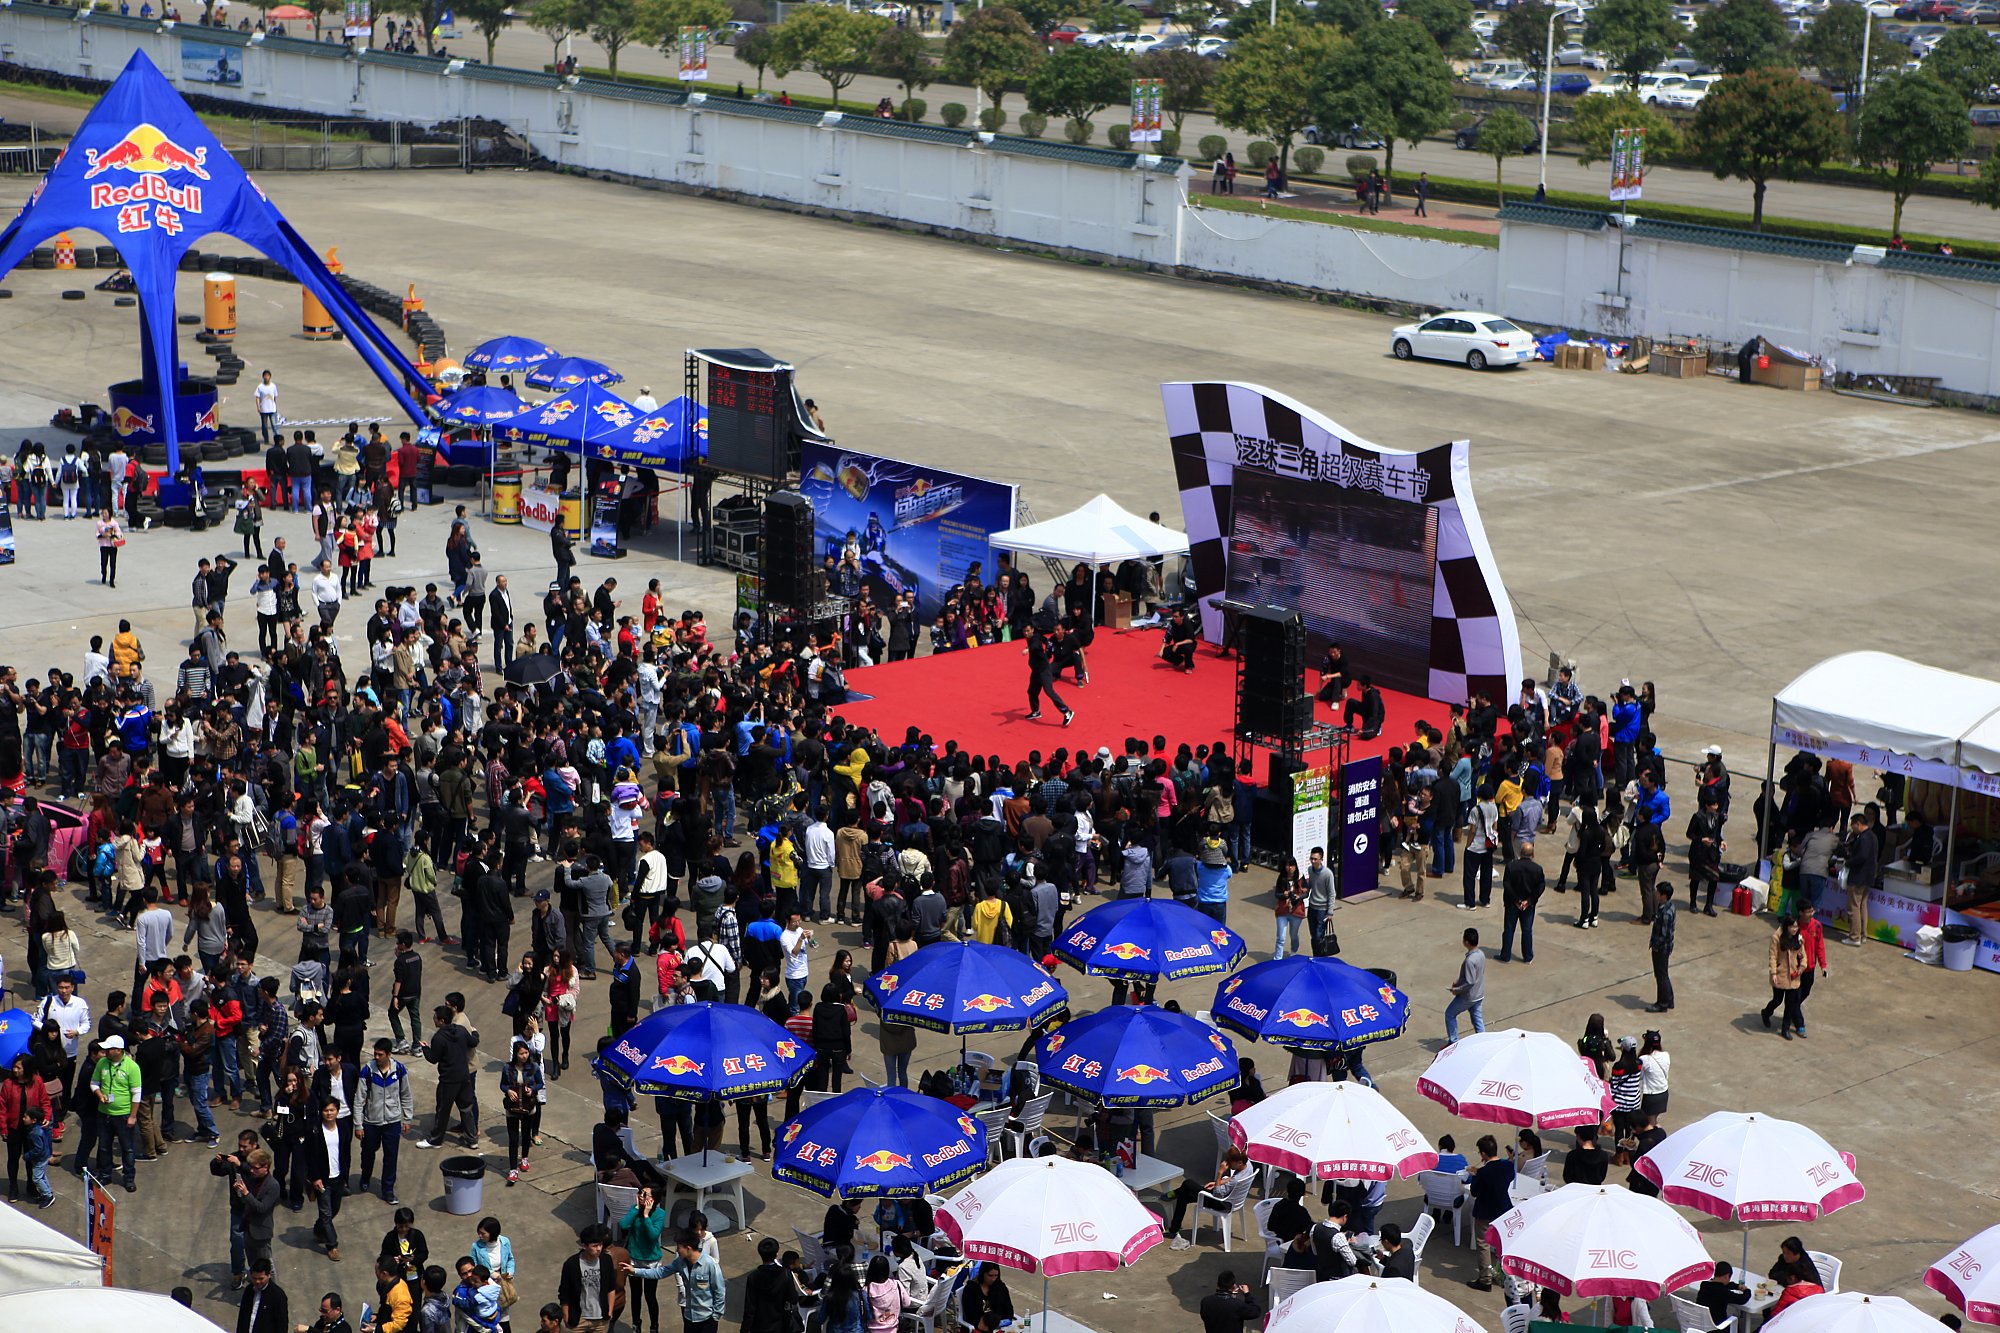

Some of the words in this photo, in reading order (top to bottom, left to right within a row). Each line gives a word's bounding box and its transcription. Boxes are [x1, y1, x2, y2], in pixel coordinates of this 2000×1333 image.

[117, 202, 183, 236] 红牛
[1235, 434, 1430, 498] 泛珠三角超级赛车节
[1859, 750, 1914, 772] 东八公
[1348, 778, 1377, 796] 消防安全
[1347, 807, 1376, 825] 请勿占用
[1068, 930, 1097, 951] 红牛
[1165, 944, 1212, 961] RedBull
[902, 989, 945, 1010] 红牛
[1021, 981, 1054, 1007] RedBull
[1228, 996, 1268, 1021] RedBull
[1341, 1004, 1379, 1027] 红牛
[723, 1054, 767, 1075] 红牛
[1062, 1054, 1102, 1079] 红牛
[1181, 1057, 1224, 1082] RedBull
[1478, 1079, 1523, 1101] ZIC
[1268, 1123, 1312, 1148] ZIC
[1386, 1128, 1418, 1151] ZIC
[796, 1141, 838, 1167] 红牛
[922, 1139, 970, 1167] RedBull
[1683, 1160, 1728, 1188] ZIC
[1805, 1161, 1839, 1188] ZIC
[955, 1190, 982, 1221] ZIC
[1050, 1221, 1098, 1245] ZIC
[1503, 1209, 1526, 1238] ZIC
[1588, 1249, 1639, 1271] ZIC
[1948, 1250, 1981, 1280] ZIC
